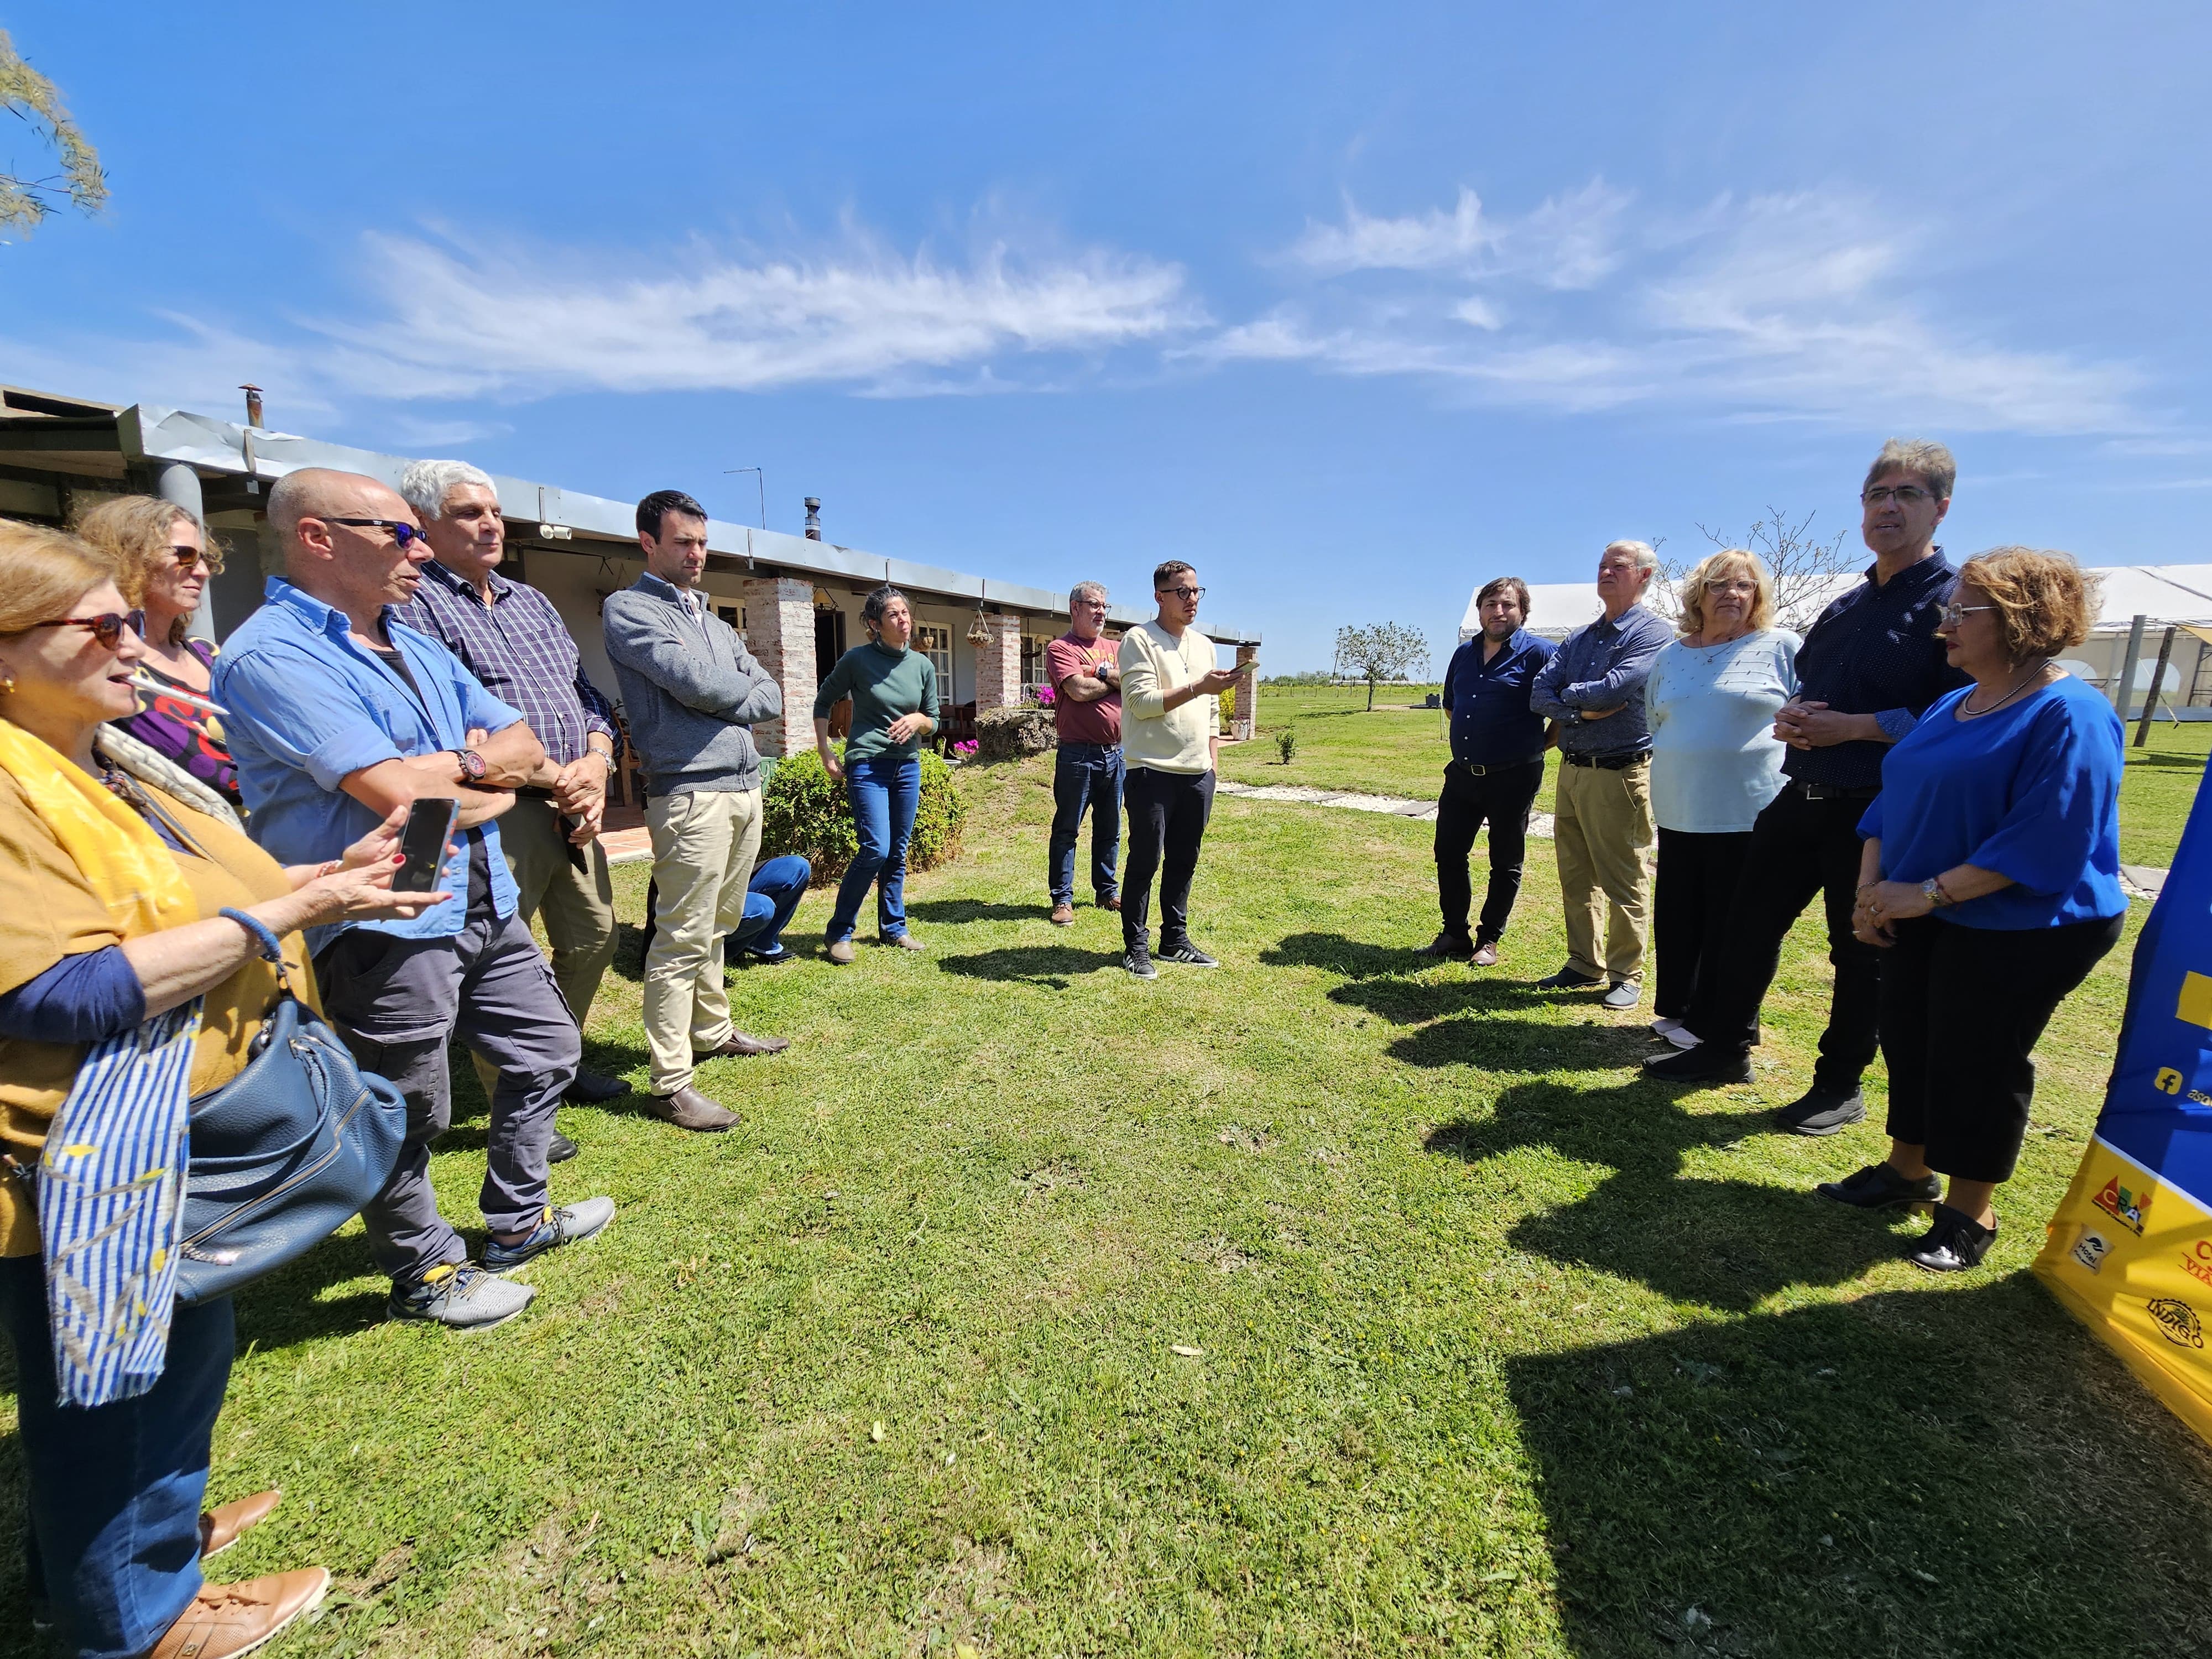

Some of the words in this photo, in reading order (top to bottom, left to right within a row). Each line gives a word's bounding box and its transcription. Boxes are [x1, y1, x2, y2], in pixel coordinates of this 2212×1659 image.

[2187, 1089, 2212, 1107] aso
[2079, 1243, 2098, 1264] Hotel
[2196, 1240, 2212, 1260] C
[2146, 1297, 2204, 1349] INDIGO
